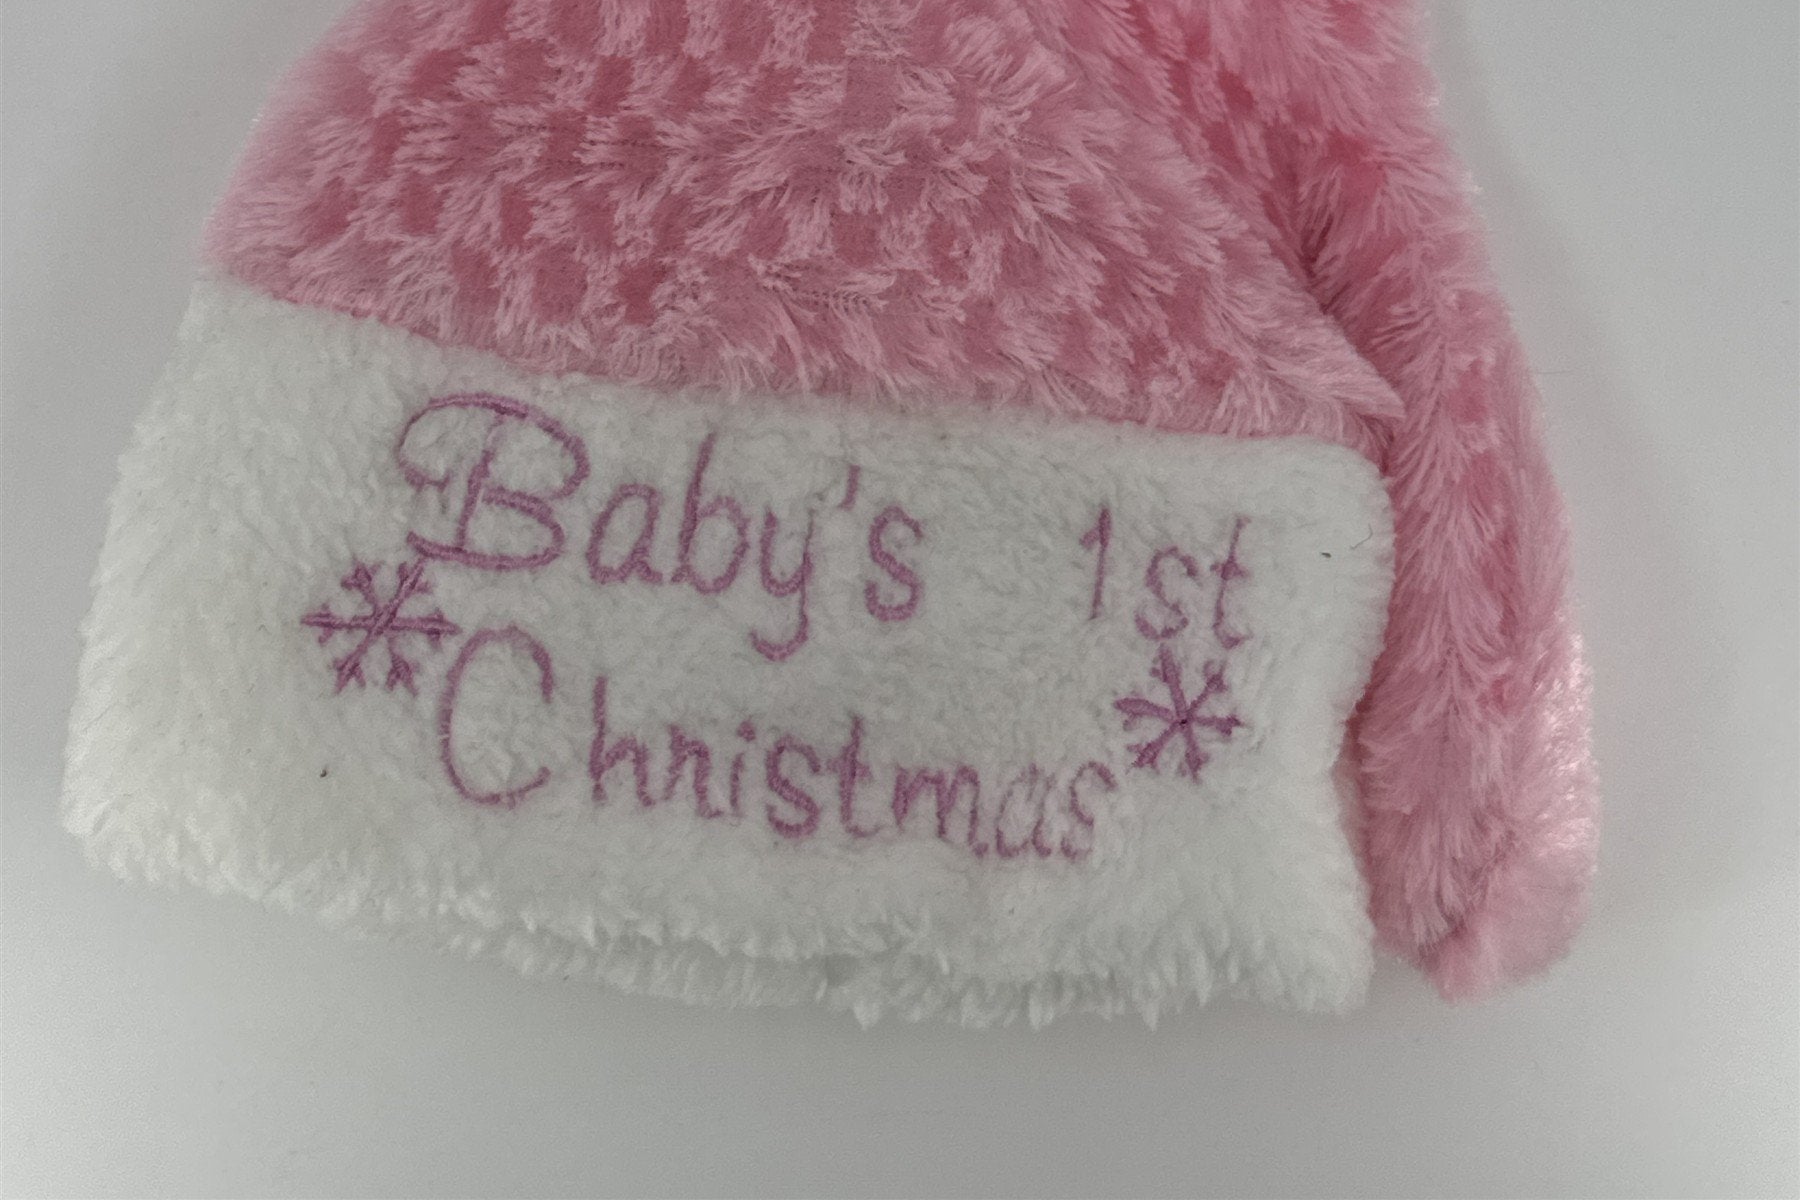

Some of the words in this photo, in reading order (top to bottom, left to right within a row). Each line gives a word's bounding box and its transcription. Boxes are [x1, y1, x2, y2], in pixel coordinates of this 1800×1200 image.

[401, 393, 924, 661] Baby's
[1079, 503, 1253, 651] 1st
[438, 625, 1116, 860] Christmas
